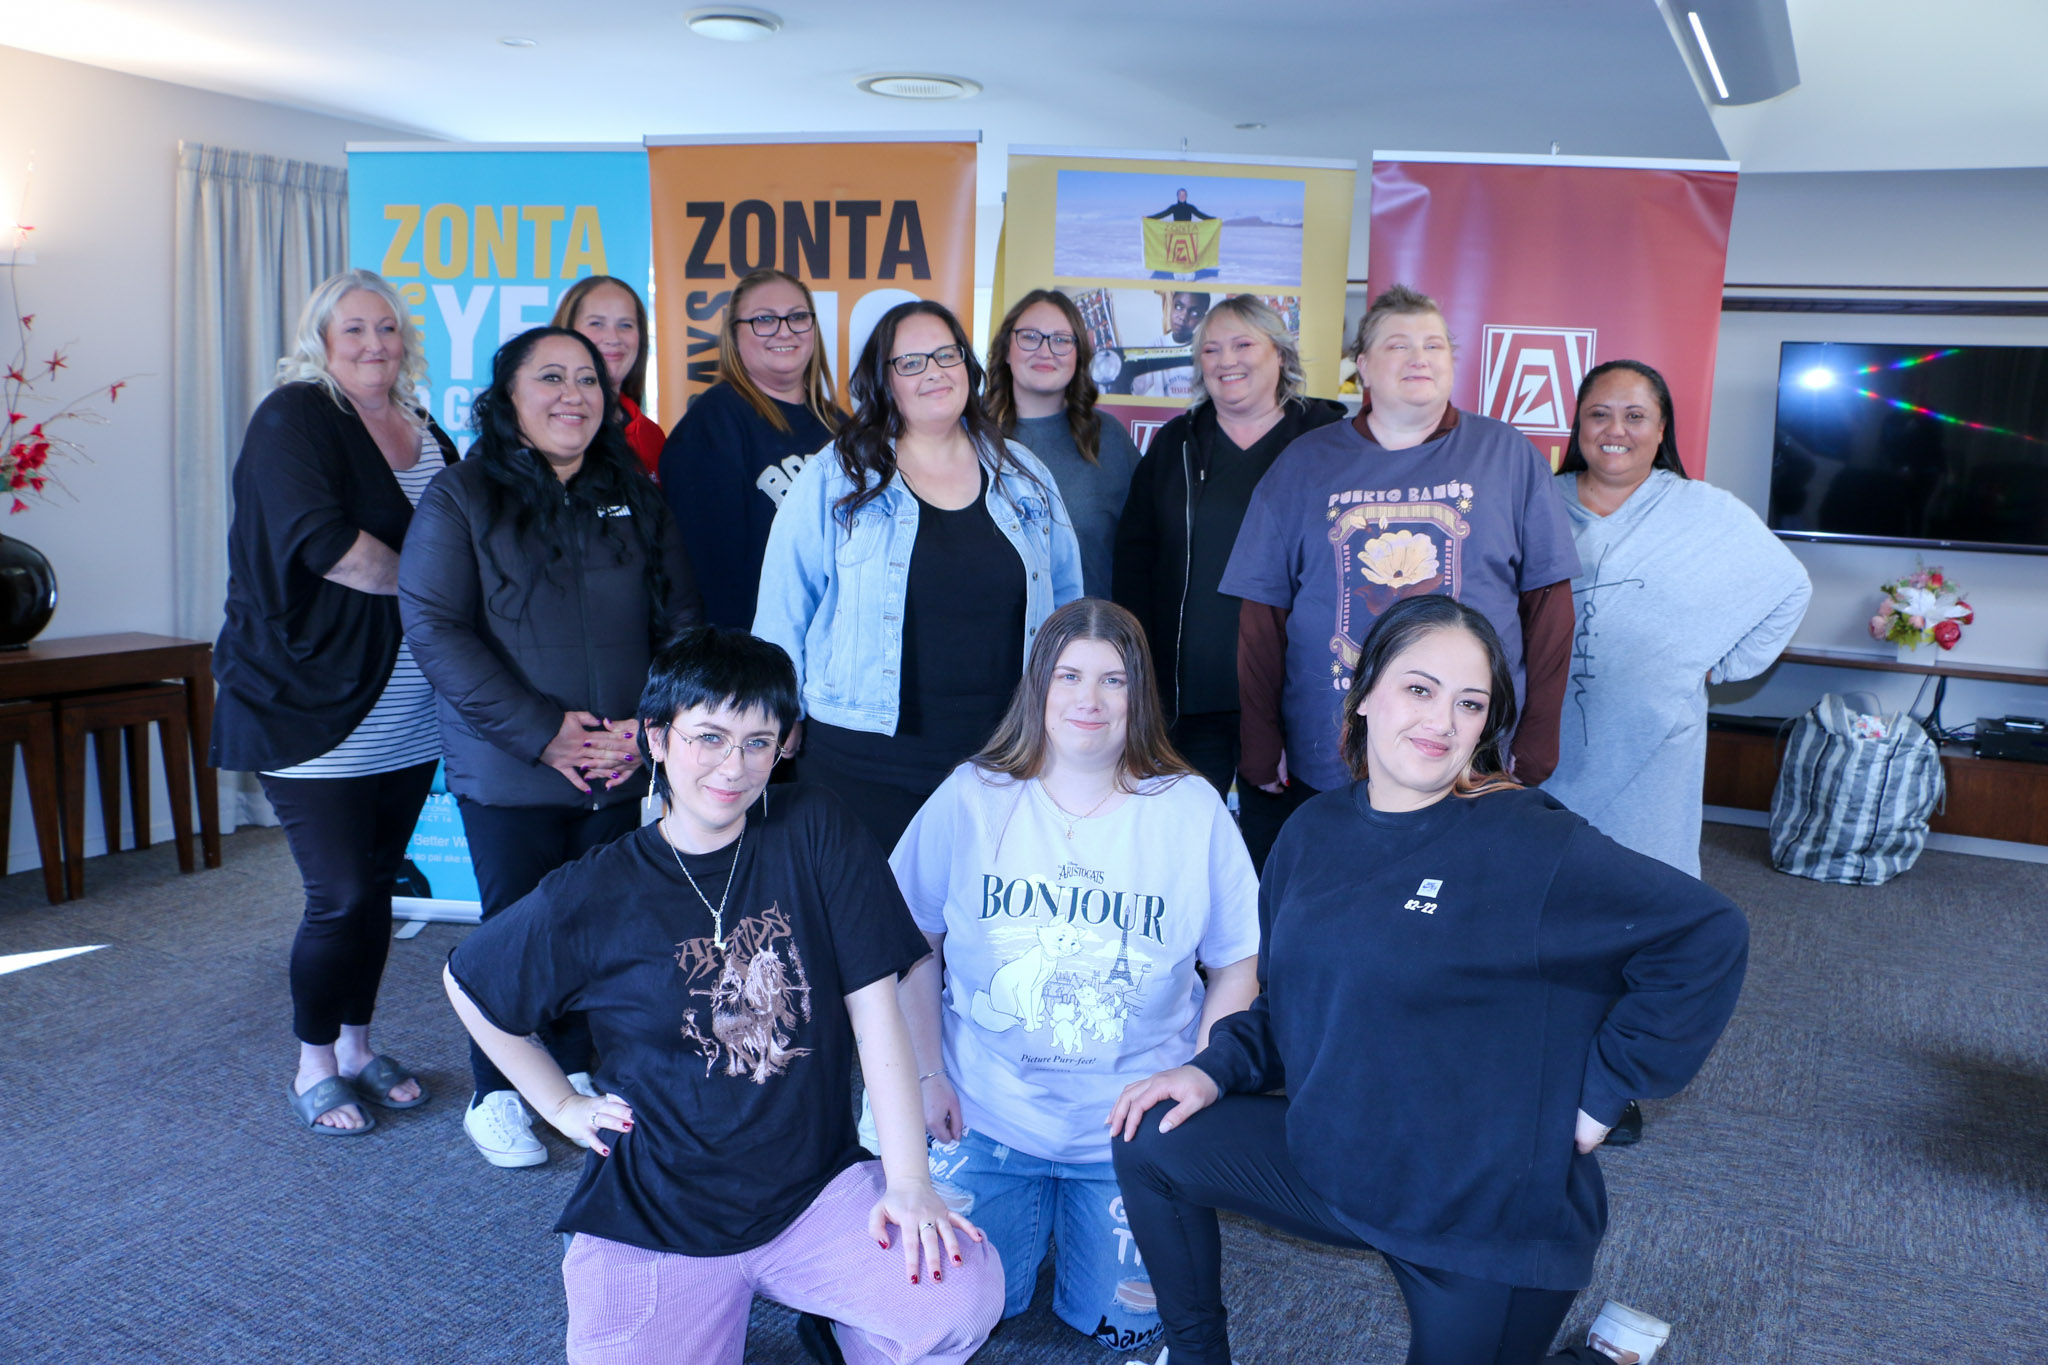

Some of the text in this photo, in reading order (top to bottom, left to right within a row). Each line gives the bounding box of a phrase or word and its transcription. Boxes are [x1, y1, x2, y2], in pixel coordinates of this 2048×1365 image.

[382, 203, 609, 279] ZONTA
[685, 199, 932, 280] ZONTA
[1328, 489, 1402, 507] PUERTO
[414, 833, 450, 847] Better
[977, 873, 1166, 946] BONJOUR
[1020, 1054, 1097, 1067] Picture Purr-fect!
